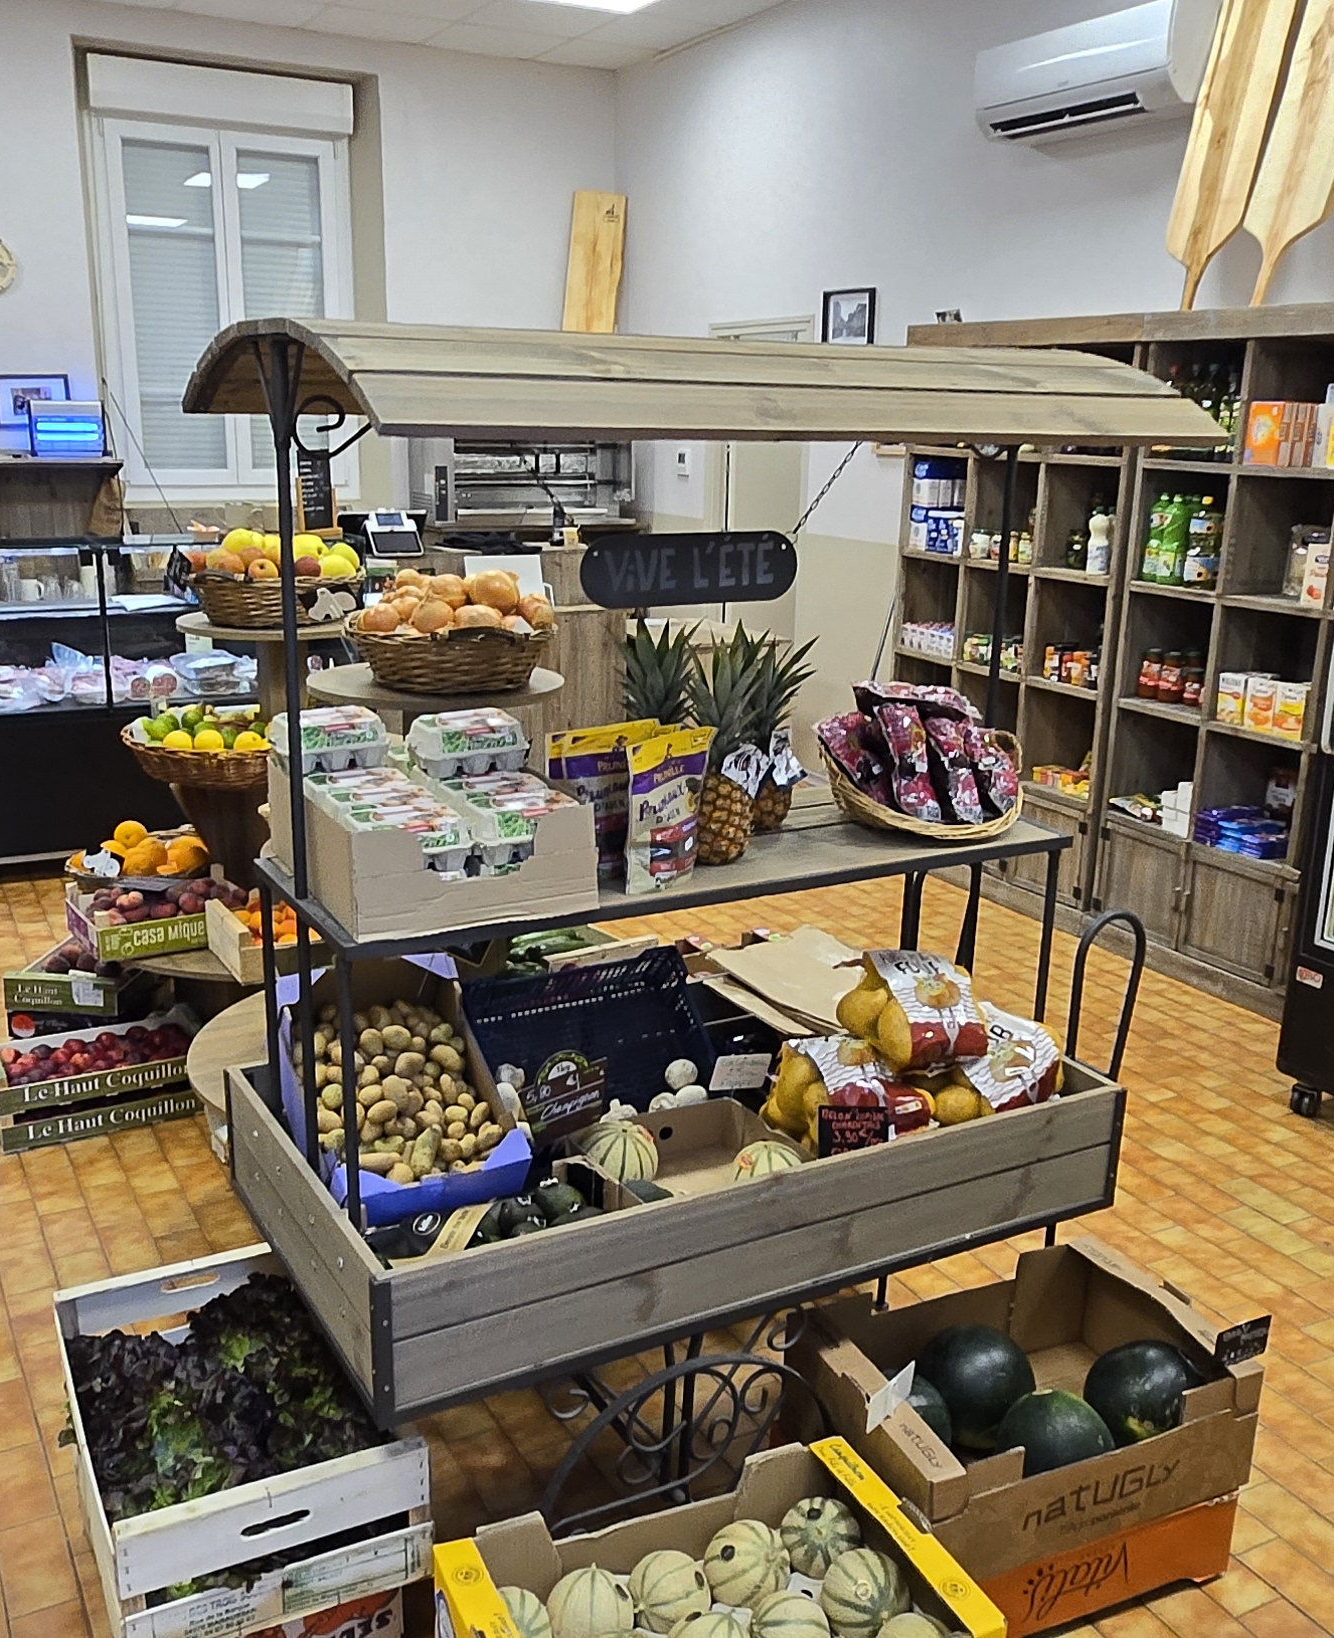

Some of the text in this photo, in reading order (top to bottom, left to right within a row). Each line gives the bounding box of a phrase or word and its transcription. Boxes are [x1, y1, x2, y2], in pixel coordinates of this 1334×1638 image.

[693, 534, 775, 588] L'ÉTÉ
[23, 1087, 48, 1103] Le
[54, 1077, 100, 1098] Haut
[28, 1098, 196, 1141] Le Haut Coquillon
